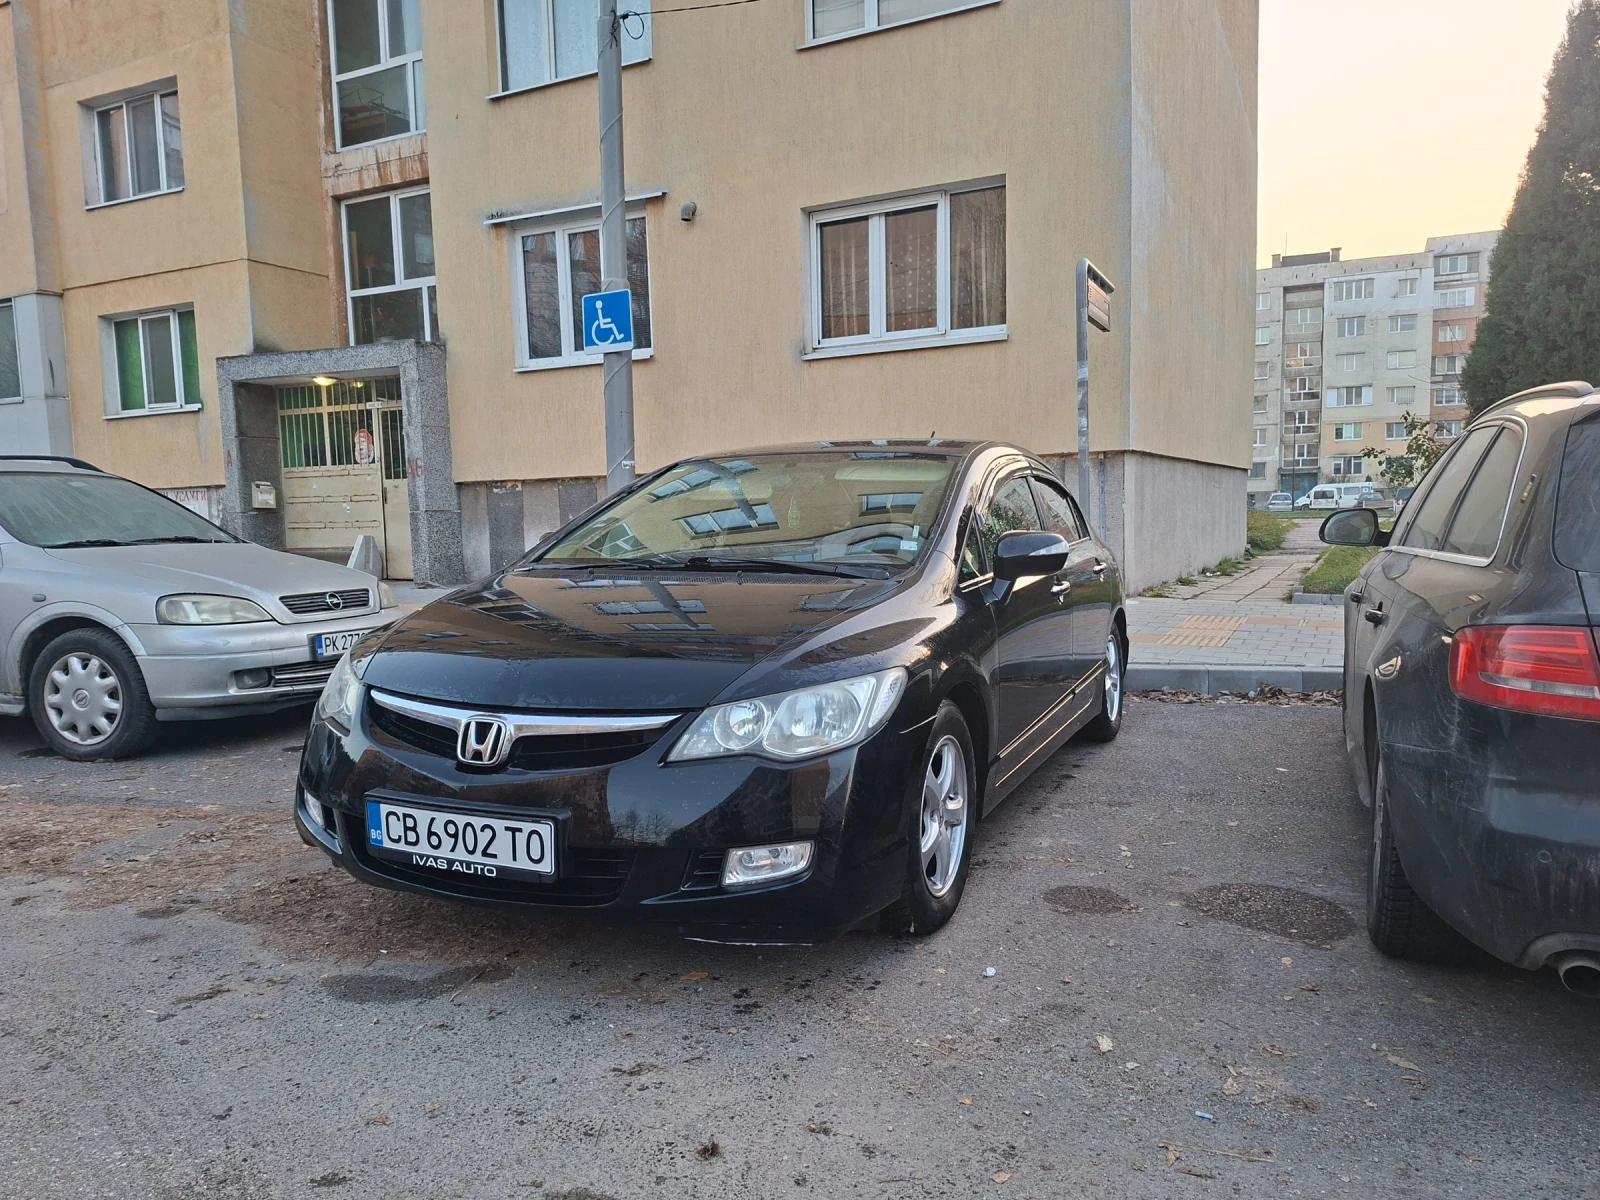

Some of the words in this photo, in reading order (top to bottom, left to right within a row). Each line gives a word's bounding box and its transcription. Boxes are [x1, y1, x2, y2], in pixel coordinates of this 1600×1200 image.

[324, 635, 339, 653] PK
[341, 632, 366, 650] 27
[370, 828, 382, 840] BG
[385, 810, 420, 847] CB
[427, 817, 498, 859] 6902
[412, 854, 448, 870] IVAS
[452, 863, 497, 877] AUTO
